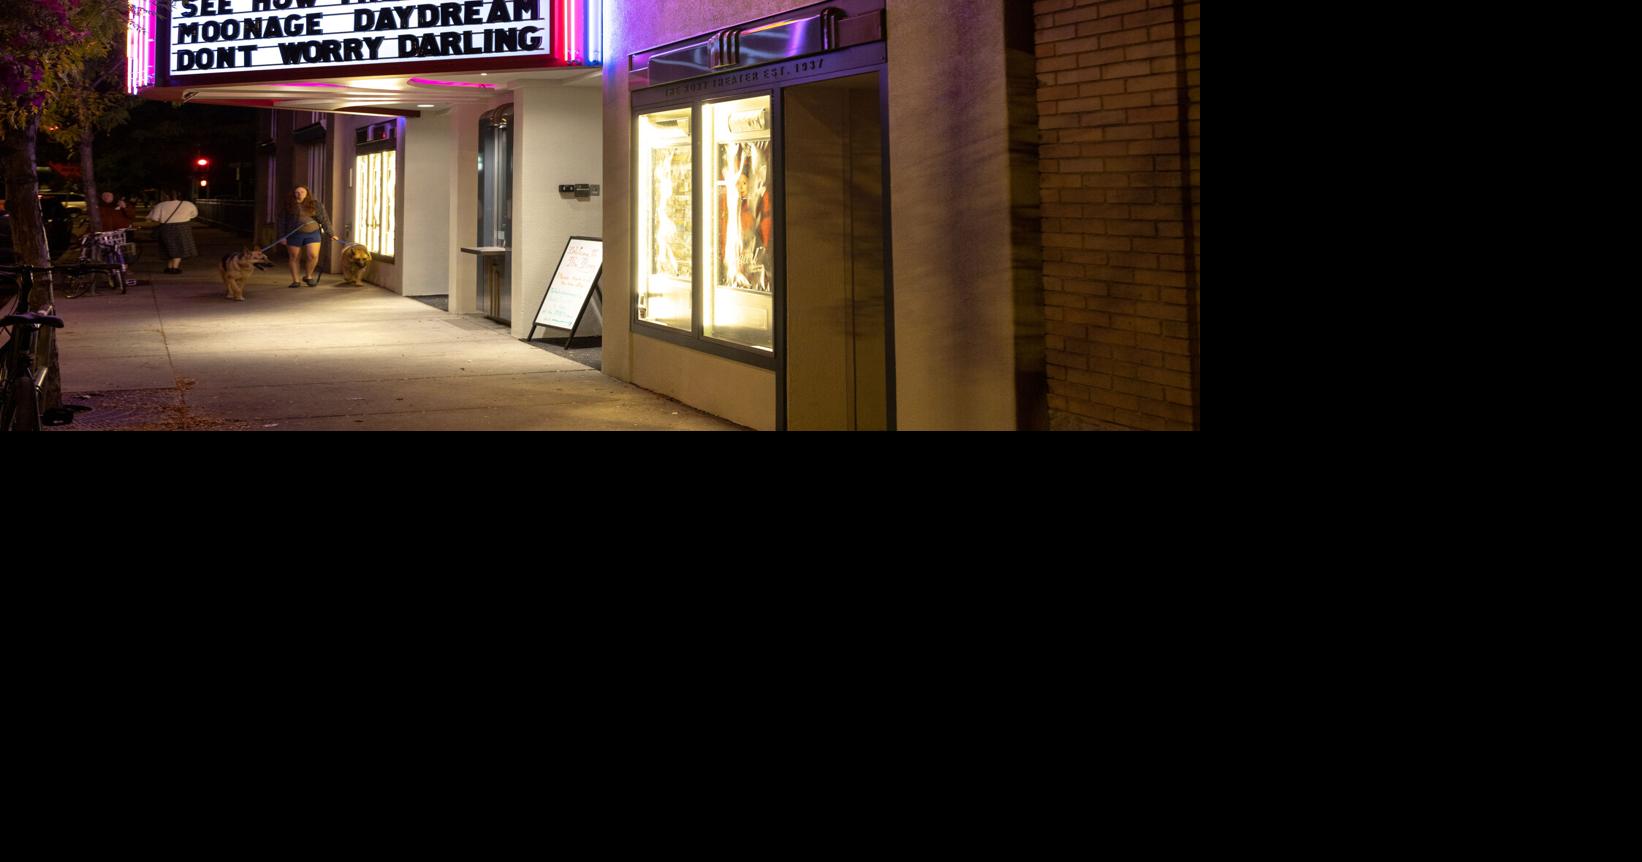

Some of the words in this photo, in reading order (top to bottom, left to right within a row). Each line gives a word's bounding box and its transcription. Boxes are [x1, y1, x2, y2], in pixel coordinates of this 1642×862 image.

[177, 12, 324, 45] MOONAGE
[354, 0, 541, 32] DAYDREAM
[181, 0, 233, 17] SEE
[177, 45, 258, 71] DONT
[278, 36, 385, 65] WORRY
[398, 26, 543, 58] DARLING
